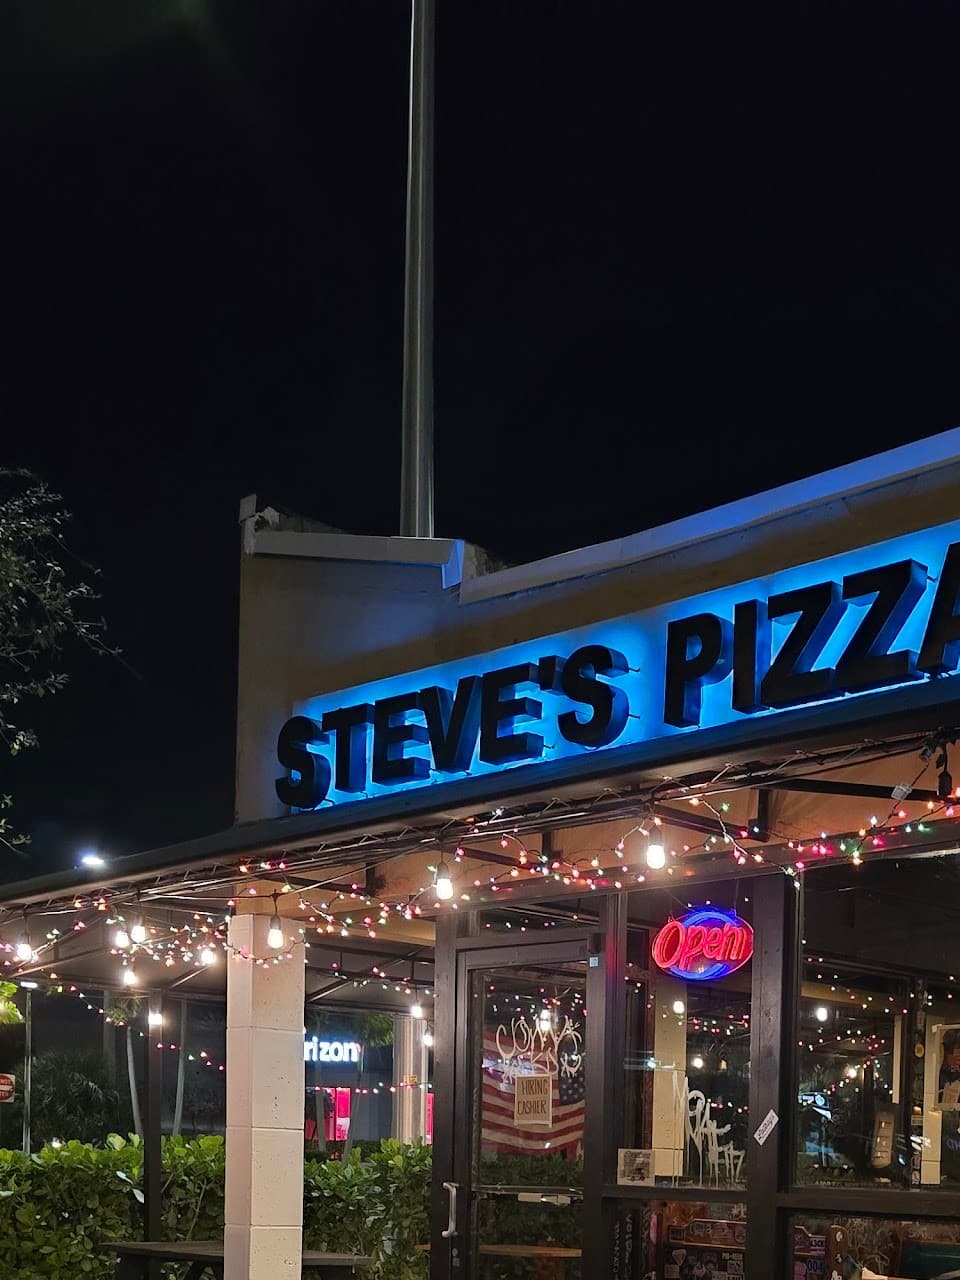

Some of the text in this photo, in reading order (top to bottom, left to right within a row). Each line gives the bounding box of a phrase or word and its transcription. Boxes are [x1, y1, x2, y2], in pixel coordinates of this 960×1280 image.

[276, 644, 628, 810] STEVE'S
[654, 920, 747, 971] Open
[304, 1036, 360, 1062] rizon
[517, 1099, 547, 1115] CASHIER
